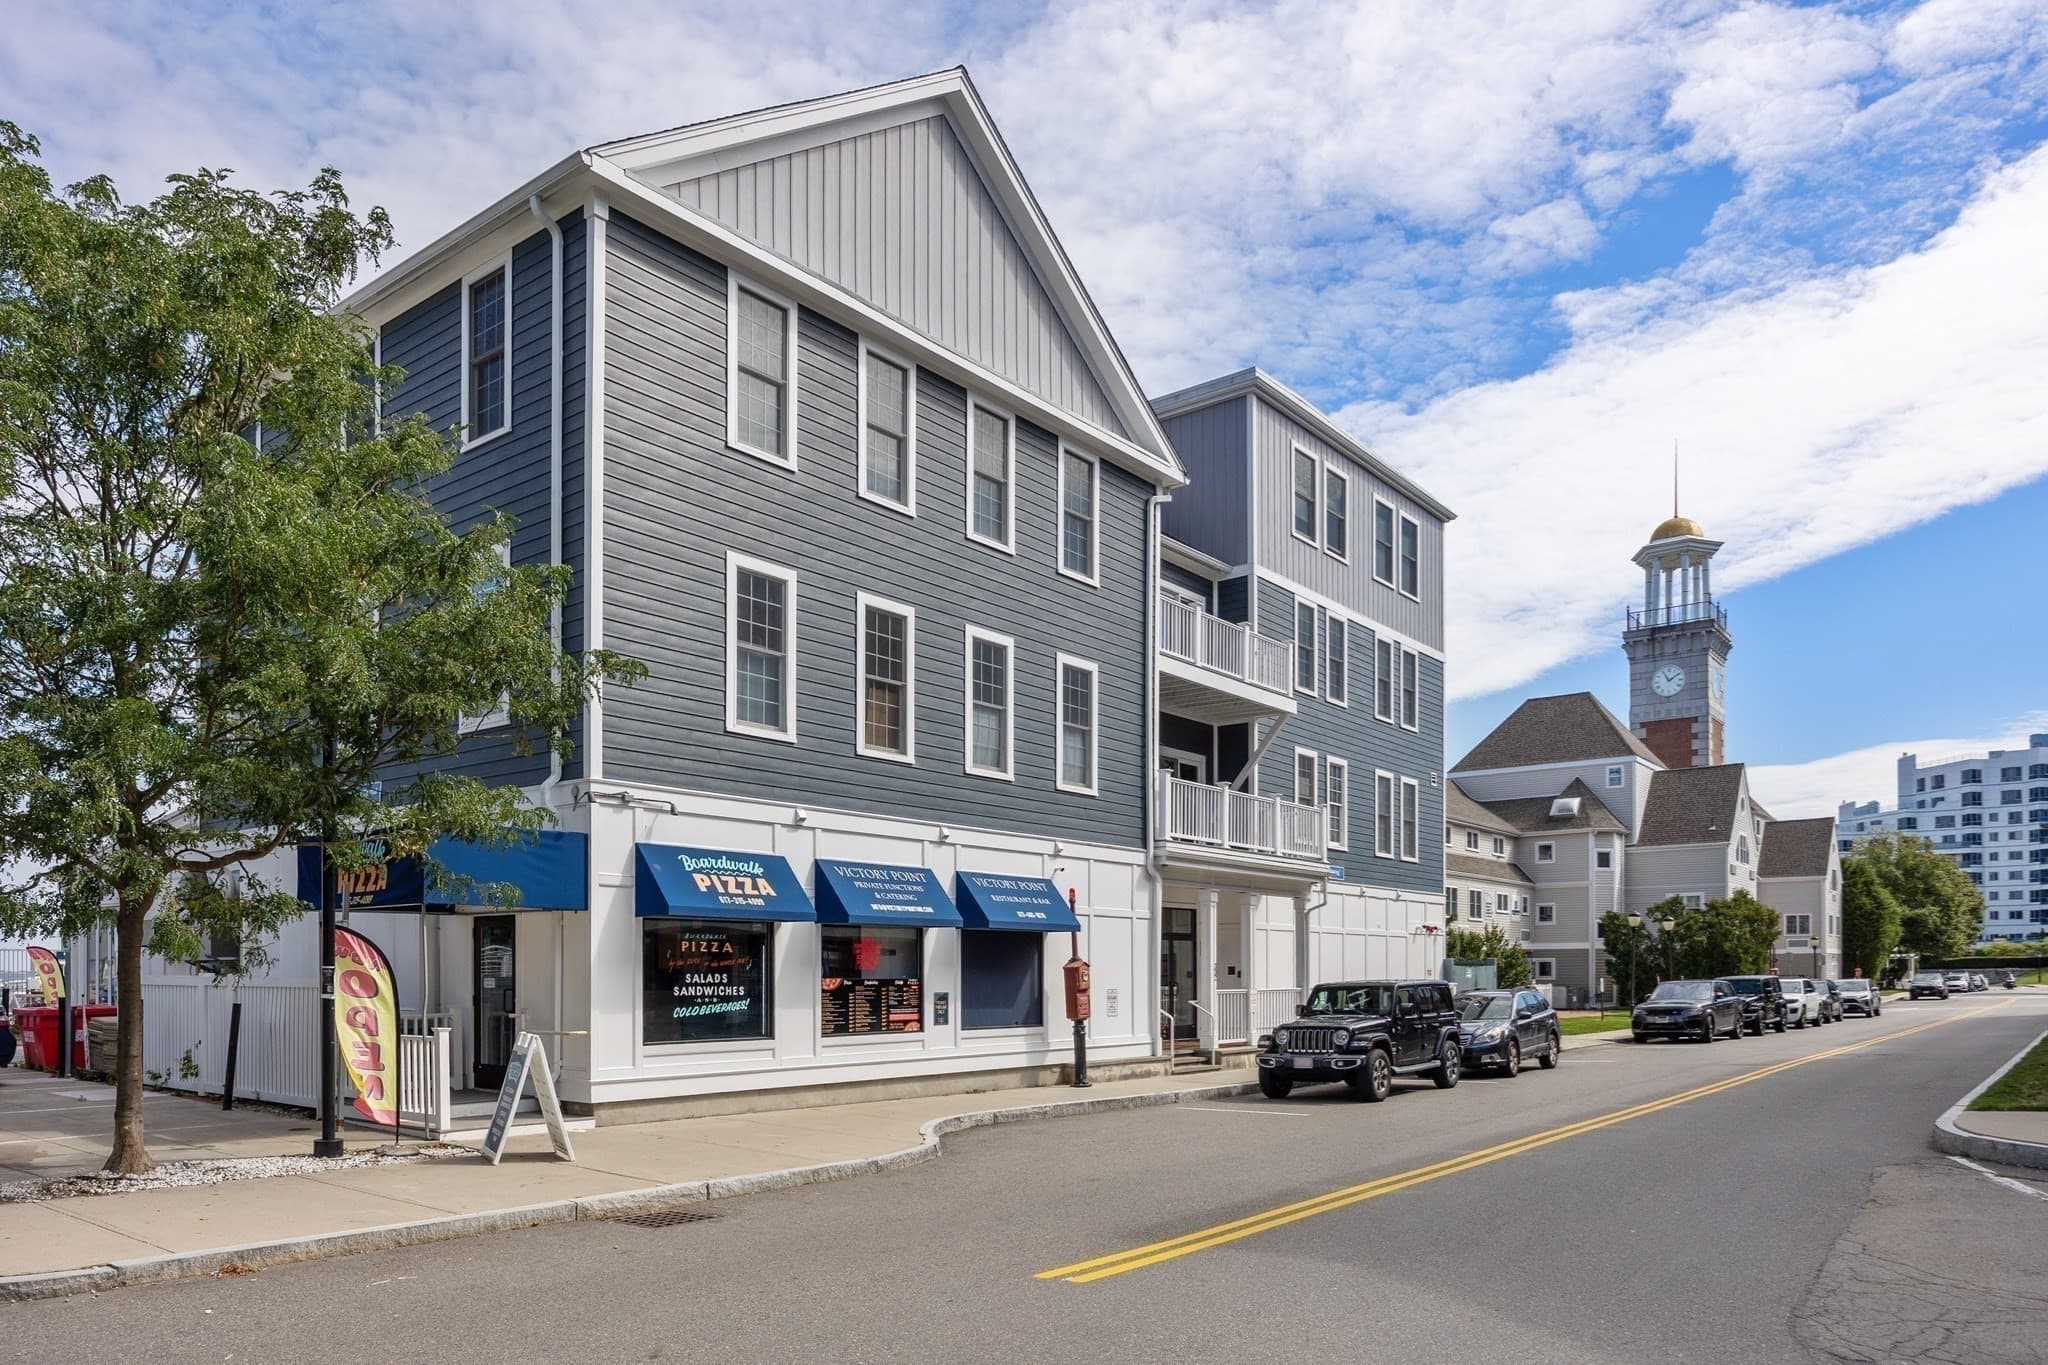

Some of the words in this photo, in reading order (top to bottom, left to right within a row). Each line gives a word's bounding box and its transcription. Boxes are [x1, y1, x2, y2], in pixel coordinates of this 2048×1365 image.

[678, 854, 764, 876] Boardwalk
[833, 866, 890, 881] VICTORY
[890, 870, 927, 883] POINT
[692, 873, 777, 896] PIZZA
[854, 881, 884, 890] PRIVATE
[884, 883, 925, 893] FUNCTIONS
[972, 877, 1017, 890] VICTORY
[1017, 881, 1048, 892] POINT
[881, 892, 918, 901] CATERING
[681, 941, 734, 953] PIZZA
[685, 973, 728, 984] SALADS
[673, 986, 745, 996] SANDWICHES
[673, 1006, 700, 1018] COLD
[699, 997, 751, 1015] BEVERAGES!
